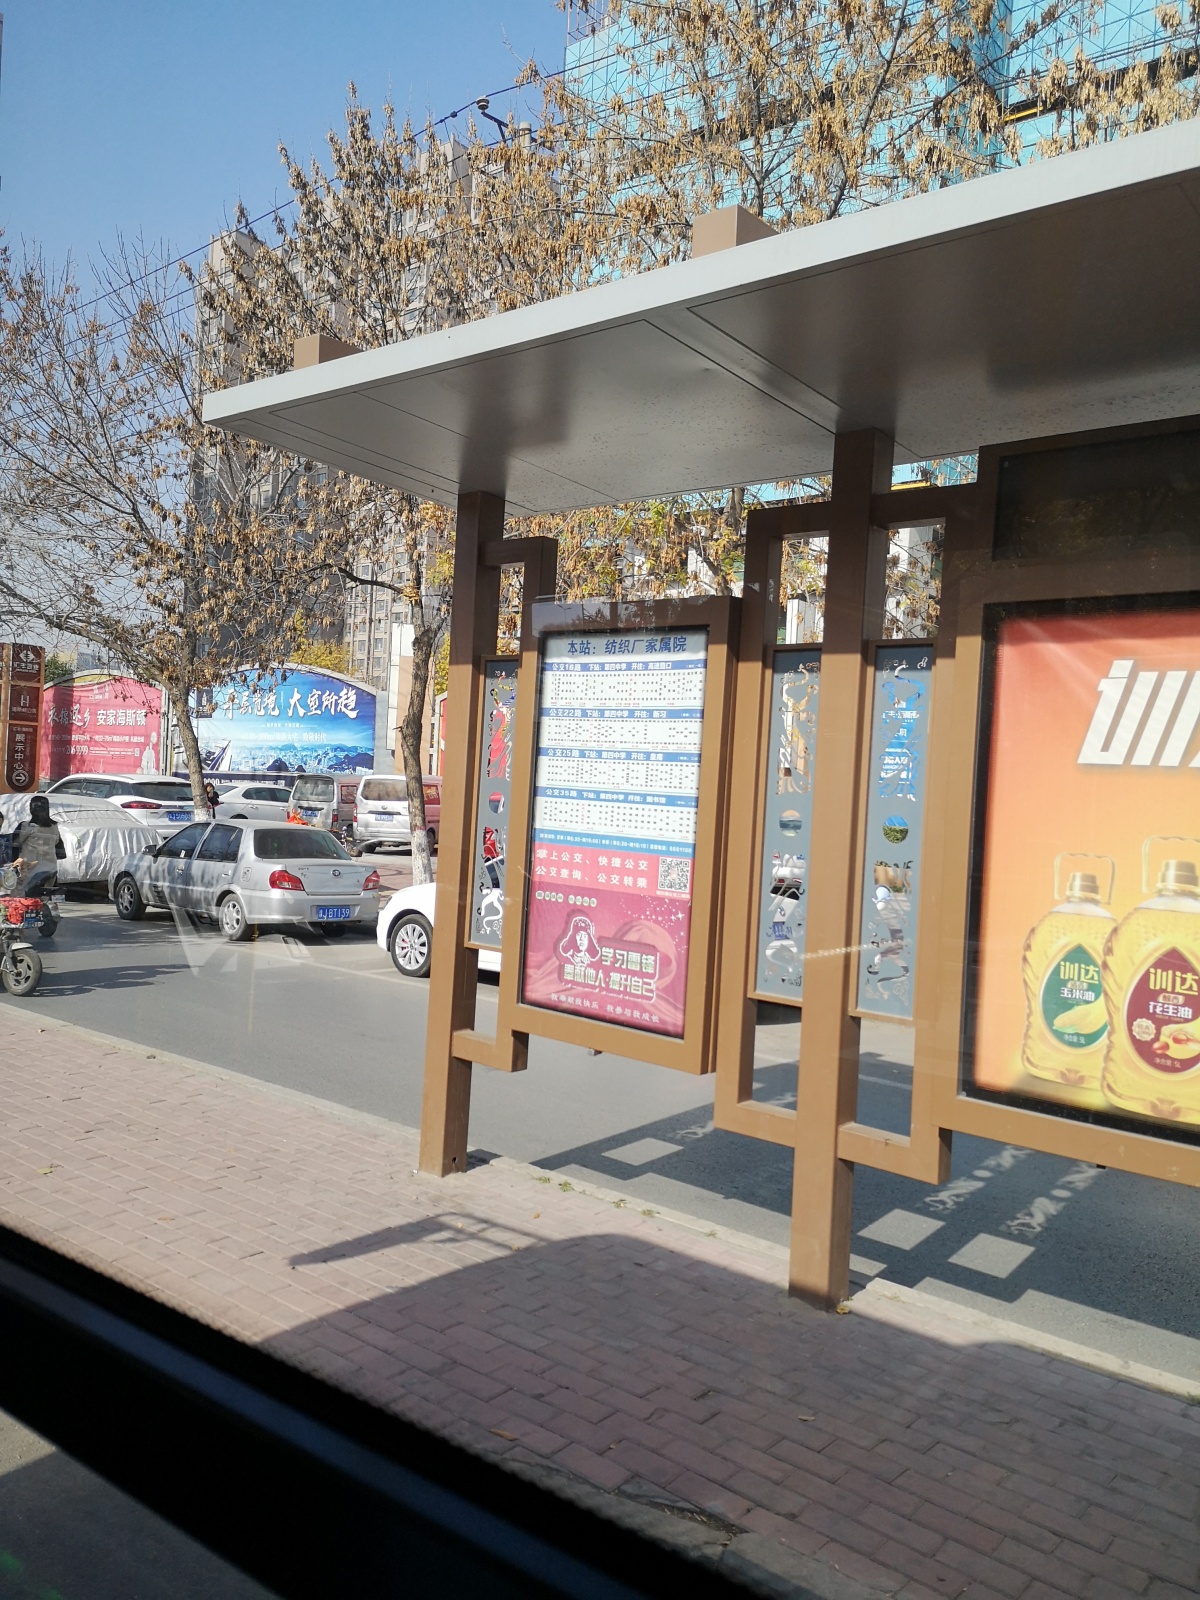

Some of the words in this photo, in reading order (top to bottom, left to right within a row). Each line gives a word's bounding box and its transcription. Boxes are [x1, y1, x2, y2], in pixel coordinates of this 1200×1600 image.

[567, 635, 687, 656] 本站：纺织厂家属院
[551, 664, 582, 672] 公交16路
[588, 662, 627, 671] 下站：第四中学
[96, 709, 147, 727] 安家海斯顿
[549, 708, 582, 718] 公交22路
[585, 709, 629, 718] 下站：第四中学
[1077, 659, 1200, 768] 训
[13, 733, 26, 771] 展示中心
[547, 749, 580, 757] 公交25路
[583, 751, 627, 760] 下站：第四中学
[545, 789, 578, 798] 公交35路
[597, 856, 649, 871] 快捷公交
[597, 873, 648, 888] 公交转乘
[602, 947, 655, 974] 学习雷锋
[1060, 987, 1095, 1001] 玉米油
[1149, 1001, 1193, 1019] 花生油
